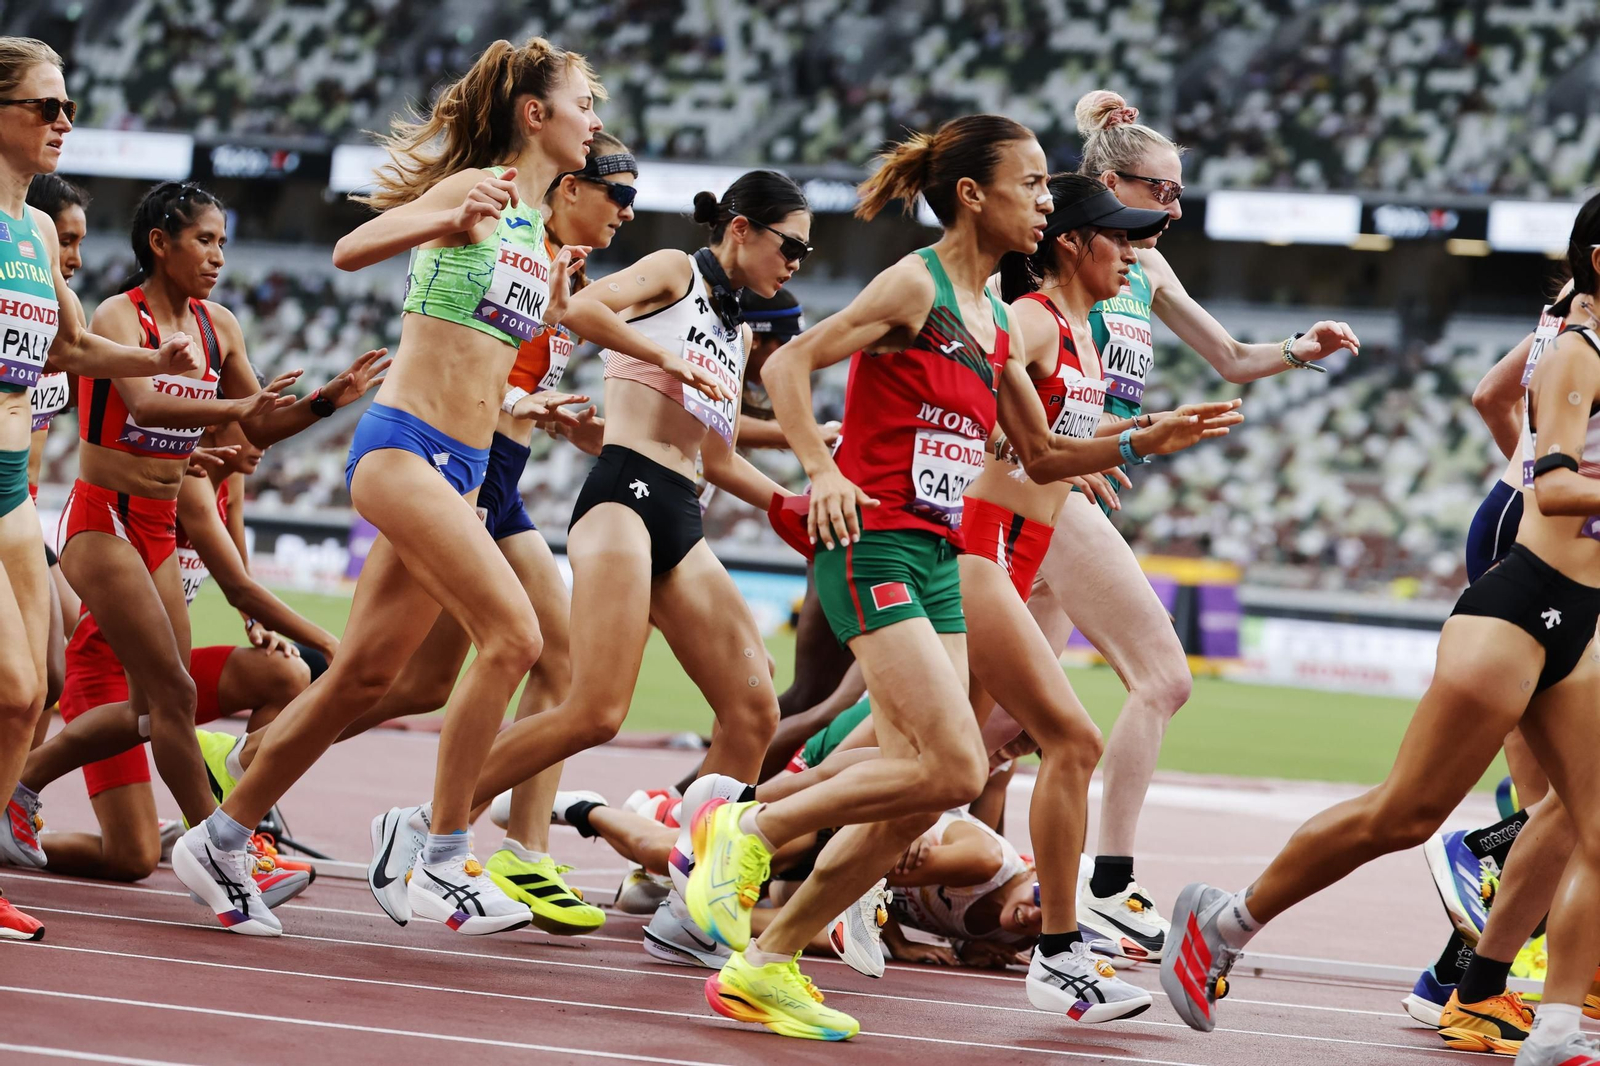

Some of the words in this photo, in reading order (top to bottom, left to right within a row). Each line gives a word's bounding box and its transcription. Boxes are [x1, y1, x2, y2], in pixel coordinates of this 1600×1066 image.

[0, 298, 58, 326] HOND
[504, 281, 545, 319] FINK
[152, 379, 216, 400] HOND
[686, 348, 739, 398] HOND
